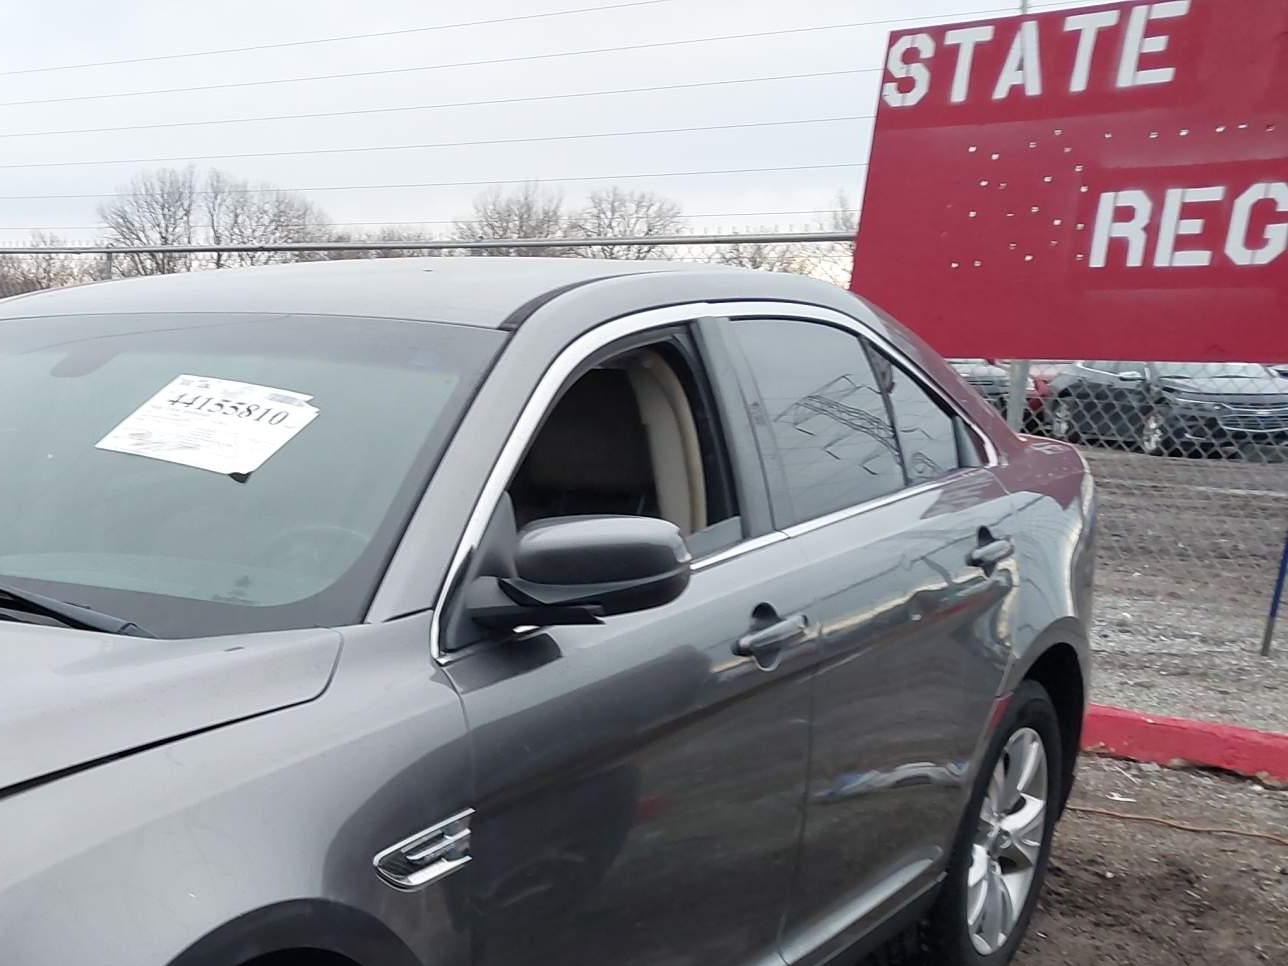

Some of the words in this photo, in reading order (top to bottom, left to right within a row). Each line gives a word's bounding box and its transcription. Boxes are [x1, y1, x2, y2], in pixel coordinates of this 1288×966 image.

[881, 0, 1192, 108] STATE
[1088, 182, 1288, 268] REG
[167, 392, 289, 426] 44155810
